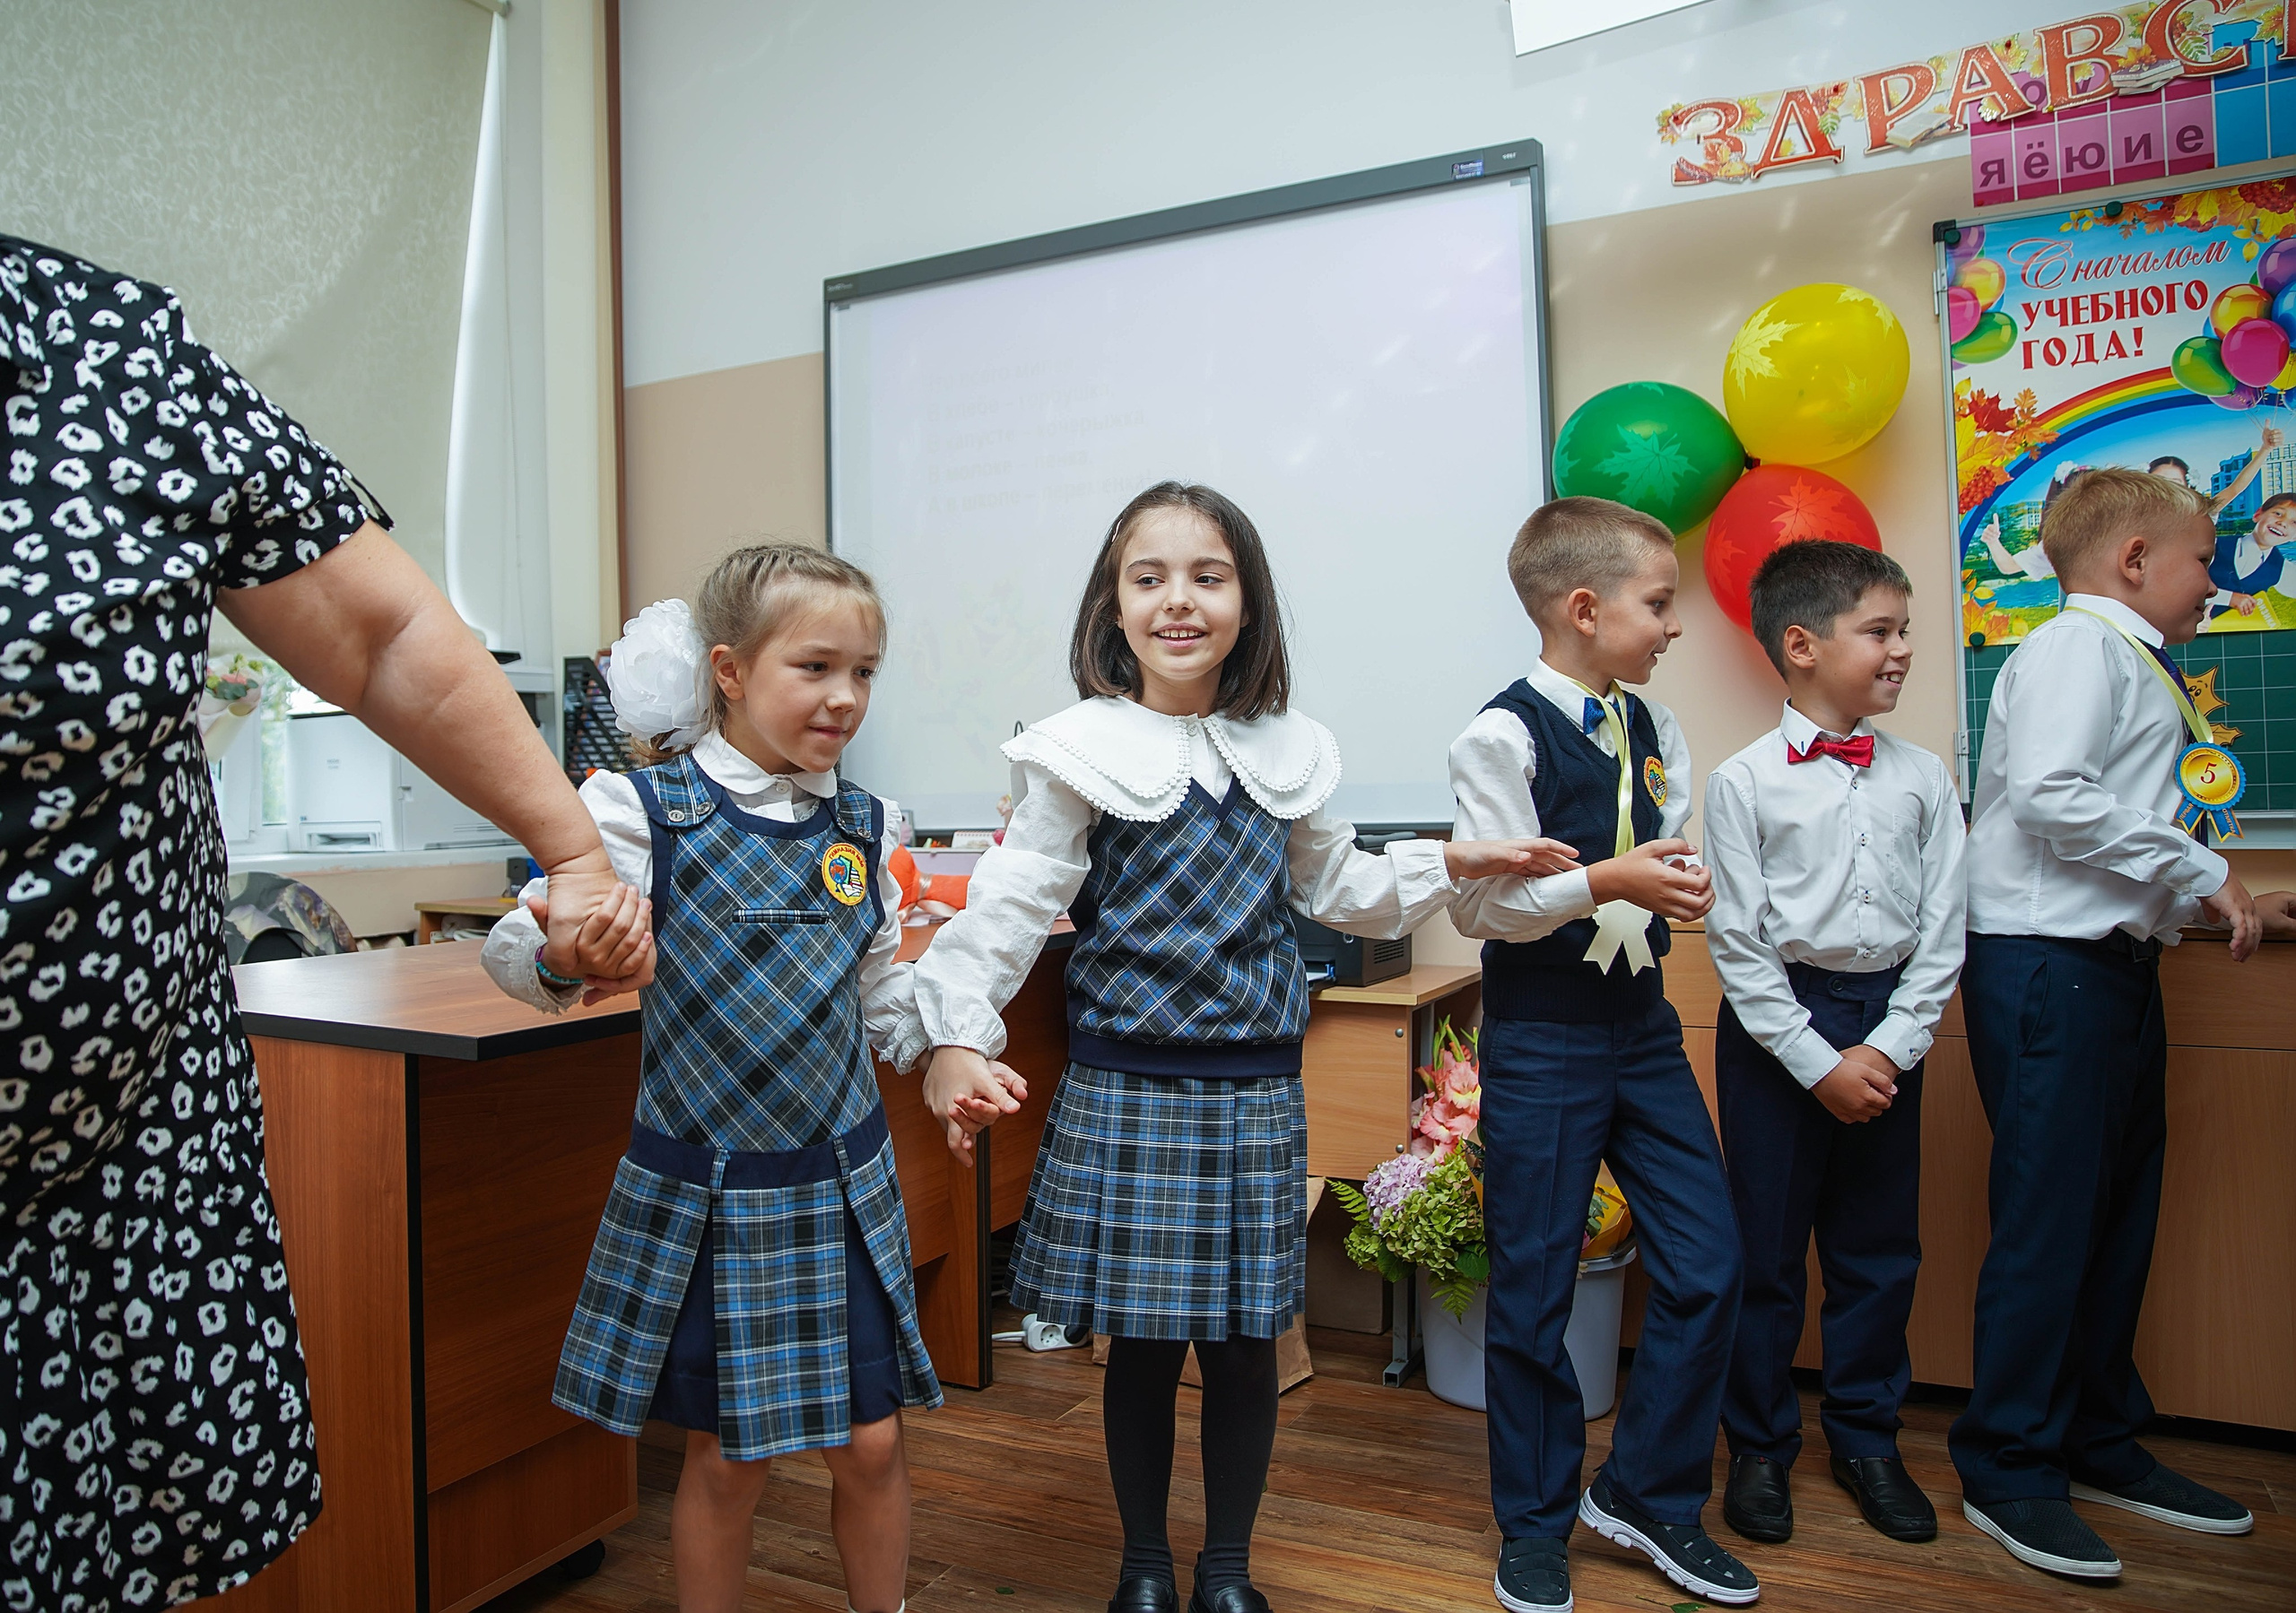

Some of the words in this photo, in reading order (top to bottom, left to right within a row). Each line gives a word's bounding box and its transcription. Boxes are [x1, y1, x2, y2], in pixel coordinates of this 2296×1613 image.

[2007, 238, 2073, 290] С
[2071, 240, 2231, 282] началом
[2021, 280, 2209, 332] УЧЕБНОГО
[2022, 326, 2144, 369] ГОДА!
[2256, 597, 2276, 629] ФИЗИКА
[2200, 762, 2217, 784] 5
[829, 846, 856, 860] ГИМНАЗИЯ
